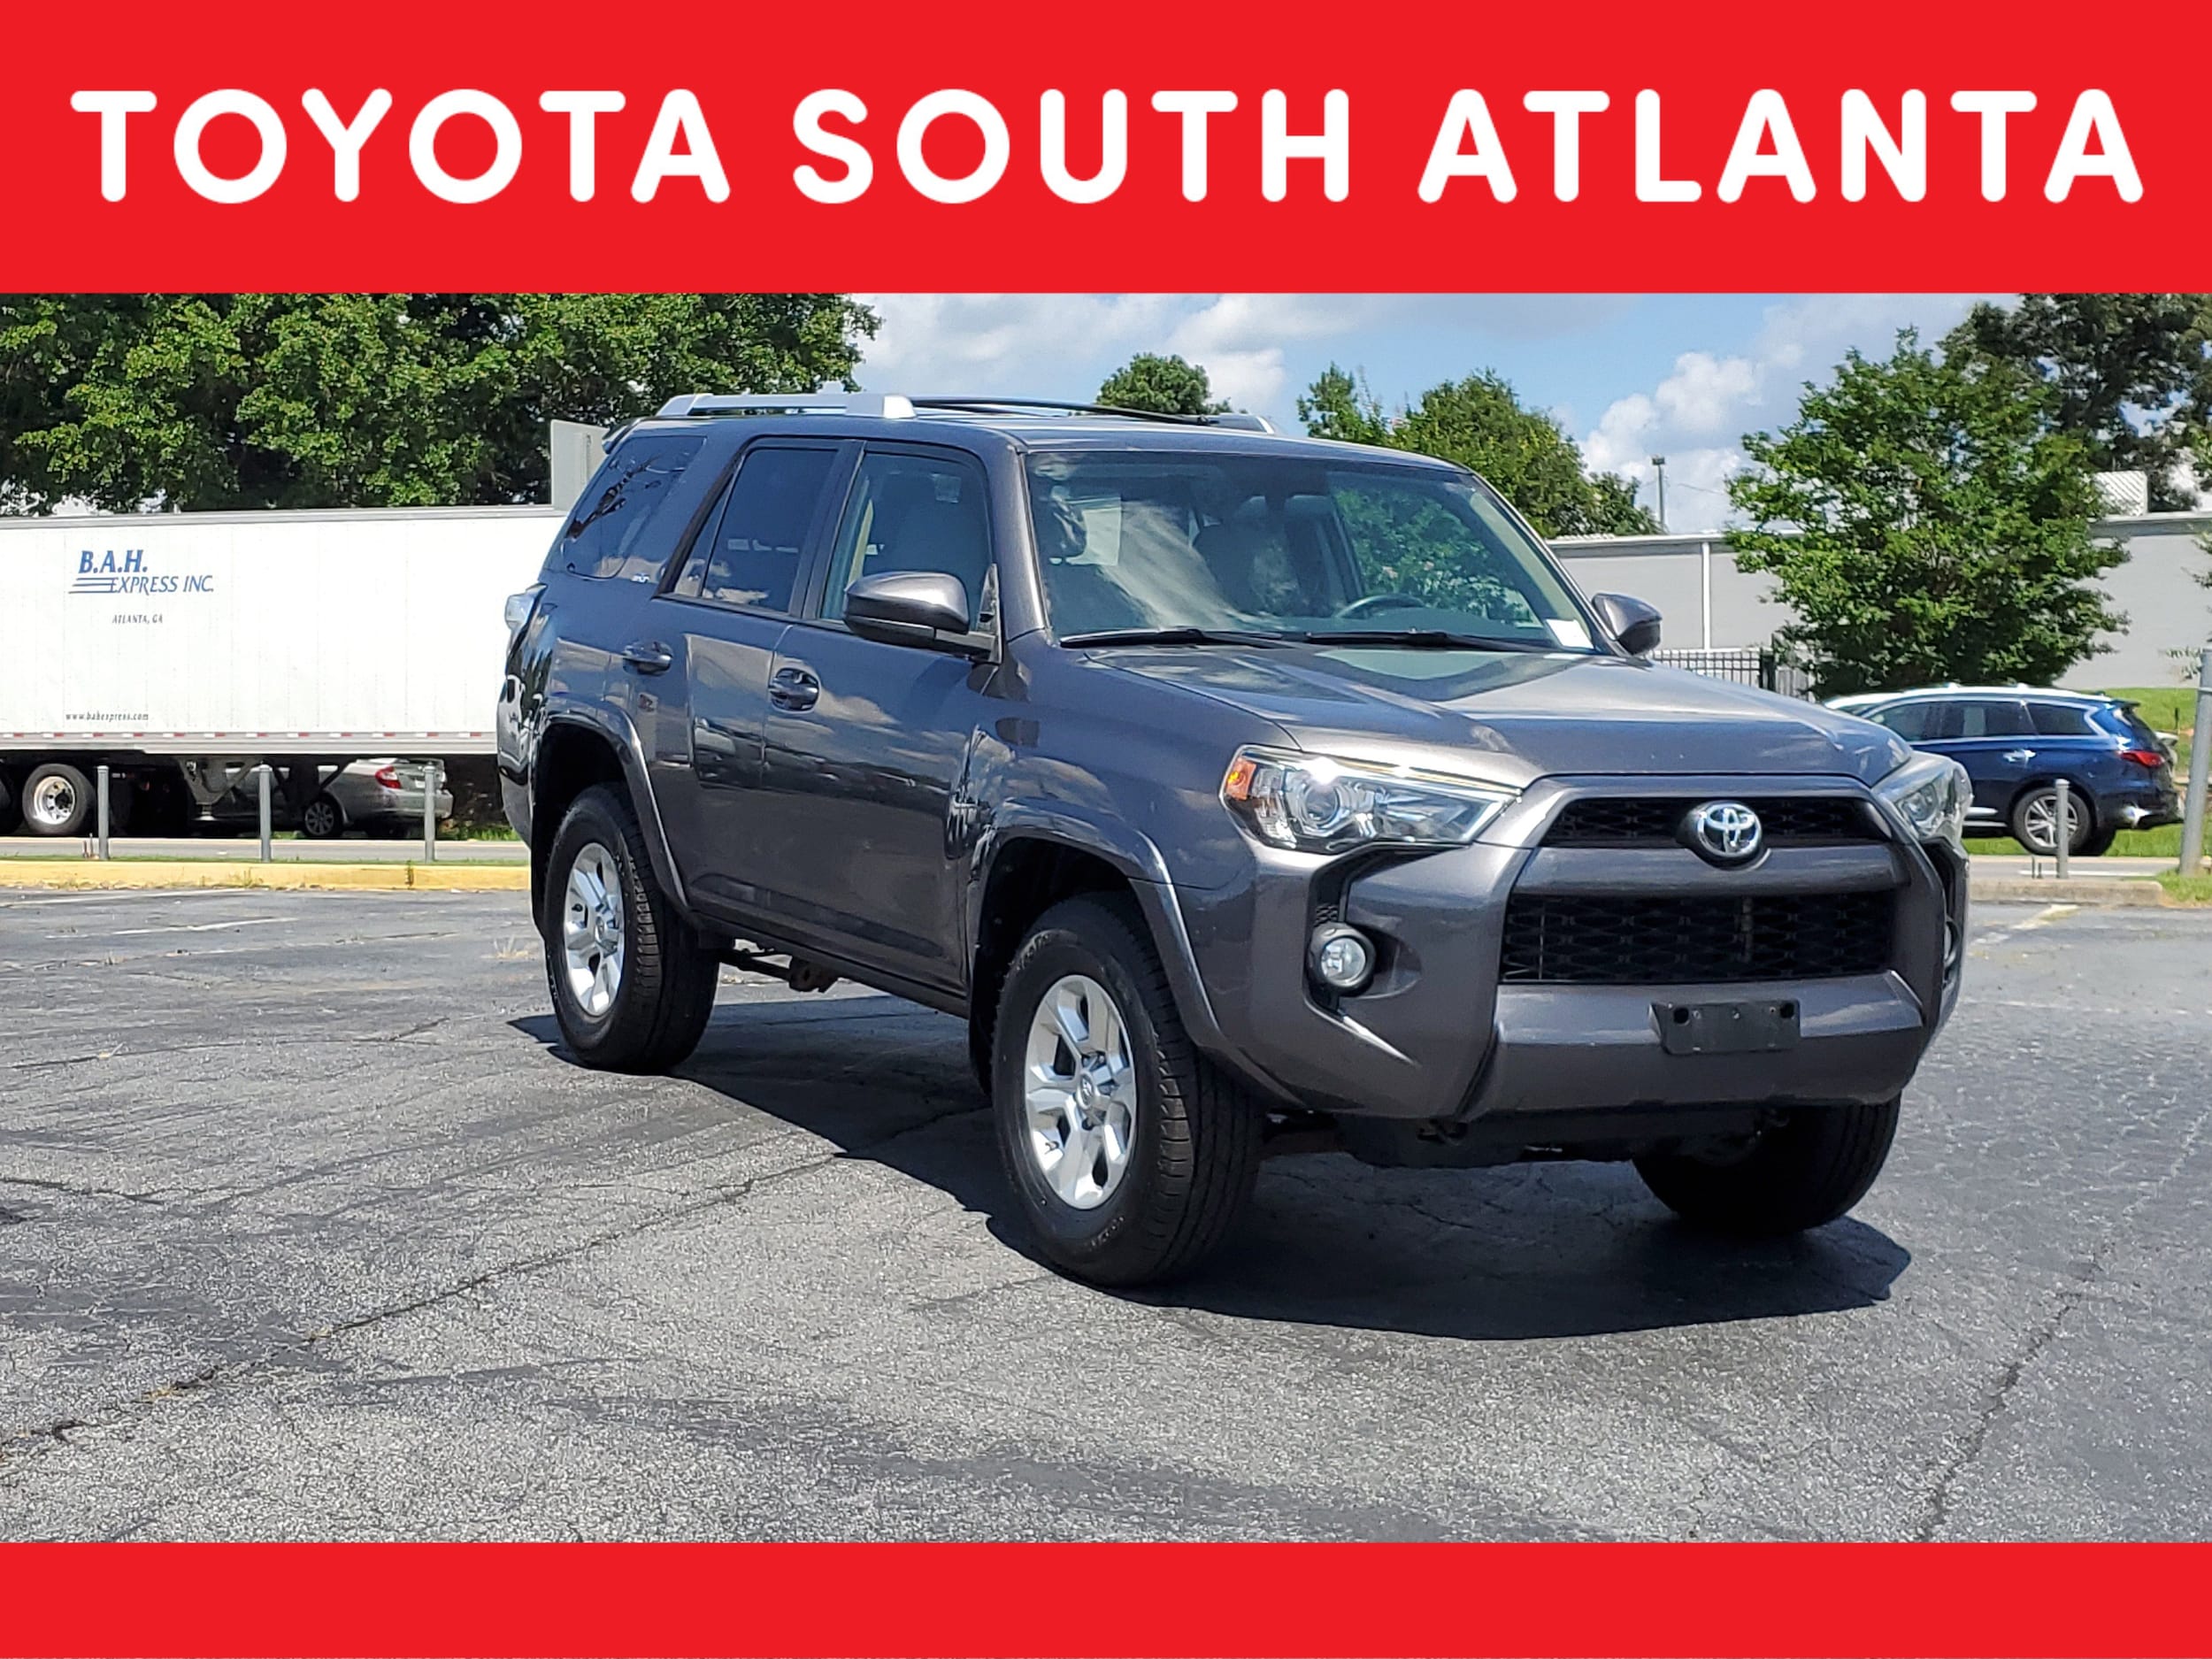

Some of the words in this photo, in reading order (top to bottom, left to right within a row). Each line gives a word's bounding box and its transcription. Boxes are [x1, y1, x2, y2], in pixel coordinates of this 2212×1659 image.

[78, 549, 149, 573] B.A.H.
[109, 576, 179, 595] EXPRESS
[183, 575, 214, 593] INC.
[152, 614, 163, 624] GA
